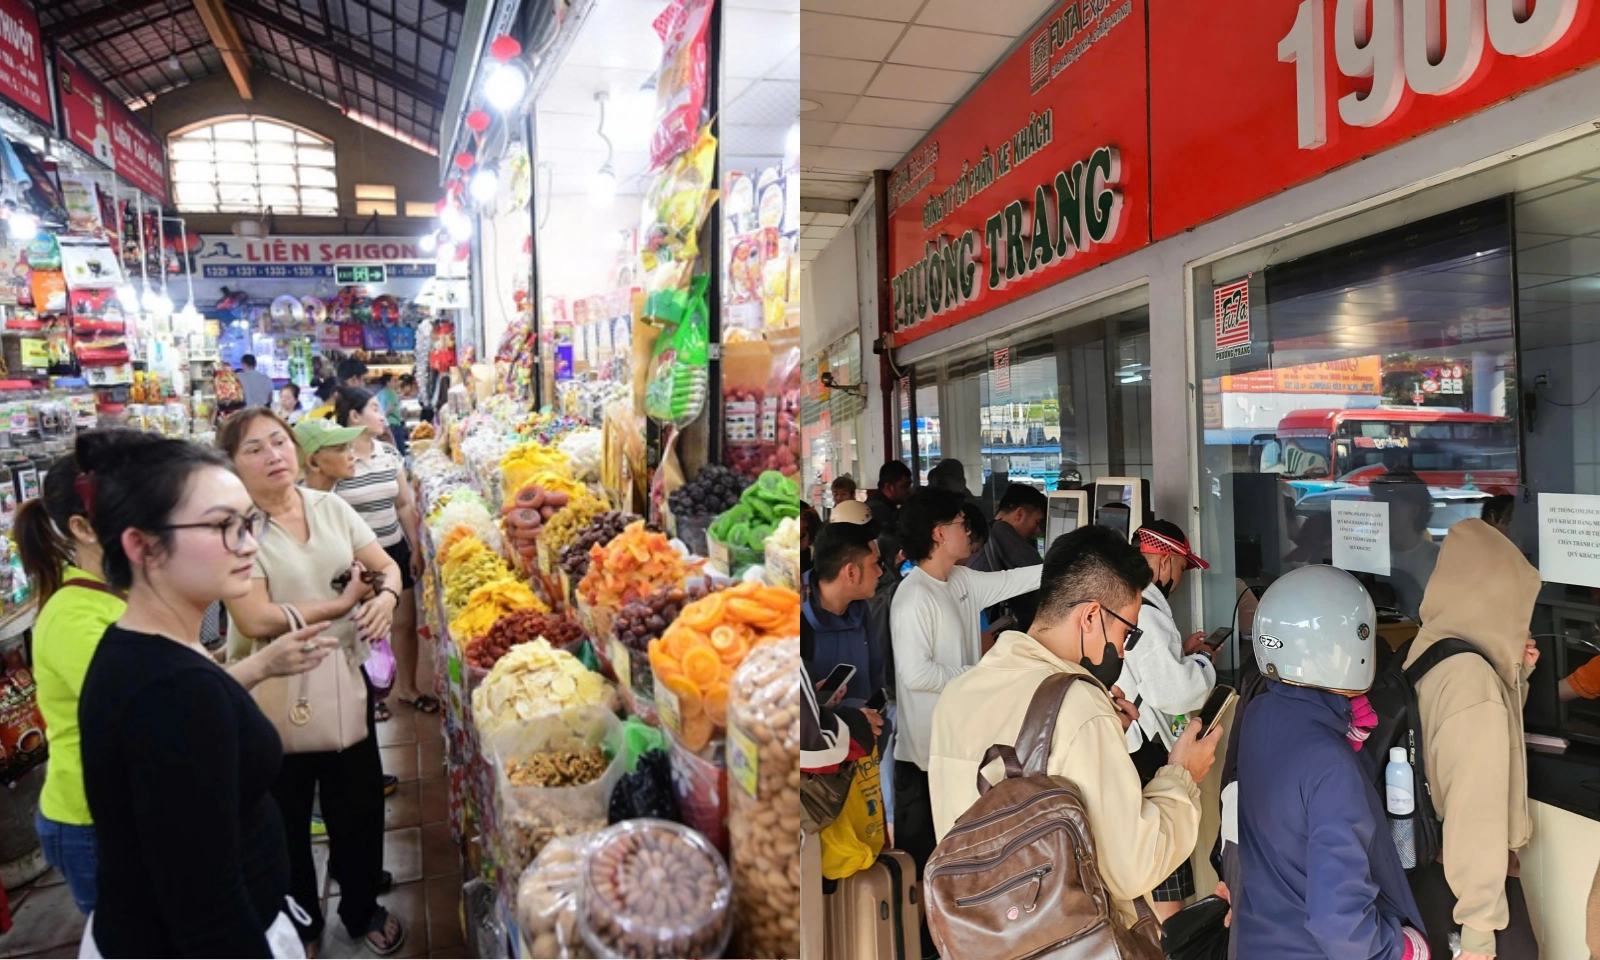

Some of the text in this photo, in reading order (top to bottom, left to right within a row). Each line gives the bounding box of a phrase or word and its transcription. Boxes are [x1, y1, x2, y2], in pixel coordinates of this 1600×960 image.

[1049, 1, 1081, 57] FUTA
[922, 194, 944, 231] CÔNG
[969, 145, 995, 199] PHẦN
[996, 140, 1012, 179] XE
[1012, 107, 1053, 168] KHÁCH
[985, 146, 1121, 290] TRANG
[246, 238, 418, 262] LIÊN SAIGON
[1234, 344, 1252, 358] TRANG
[1558, 517, 1577, 525] KHÁCH
[1572, 540, 1591, 548] THÀNH
[1567, 550, 1578, 558] QUÝ
